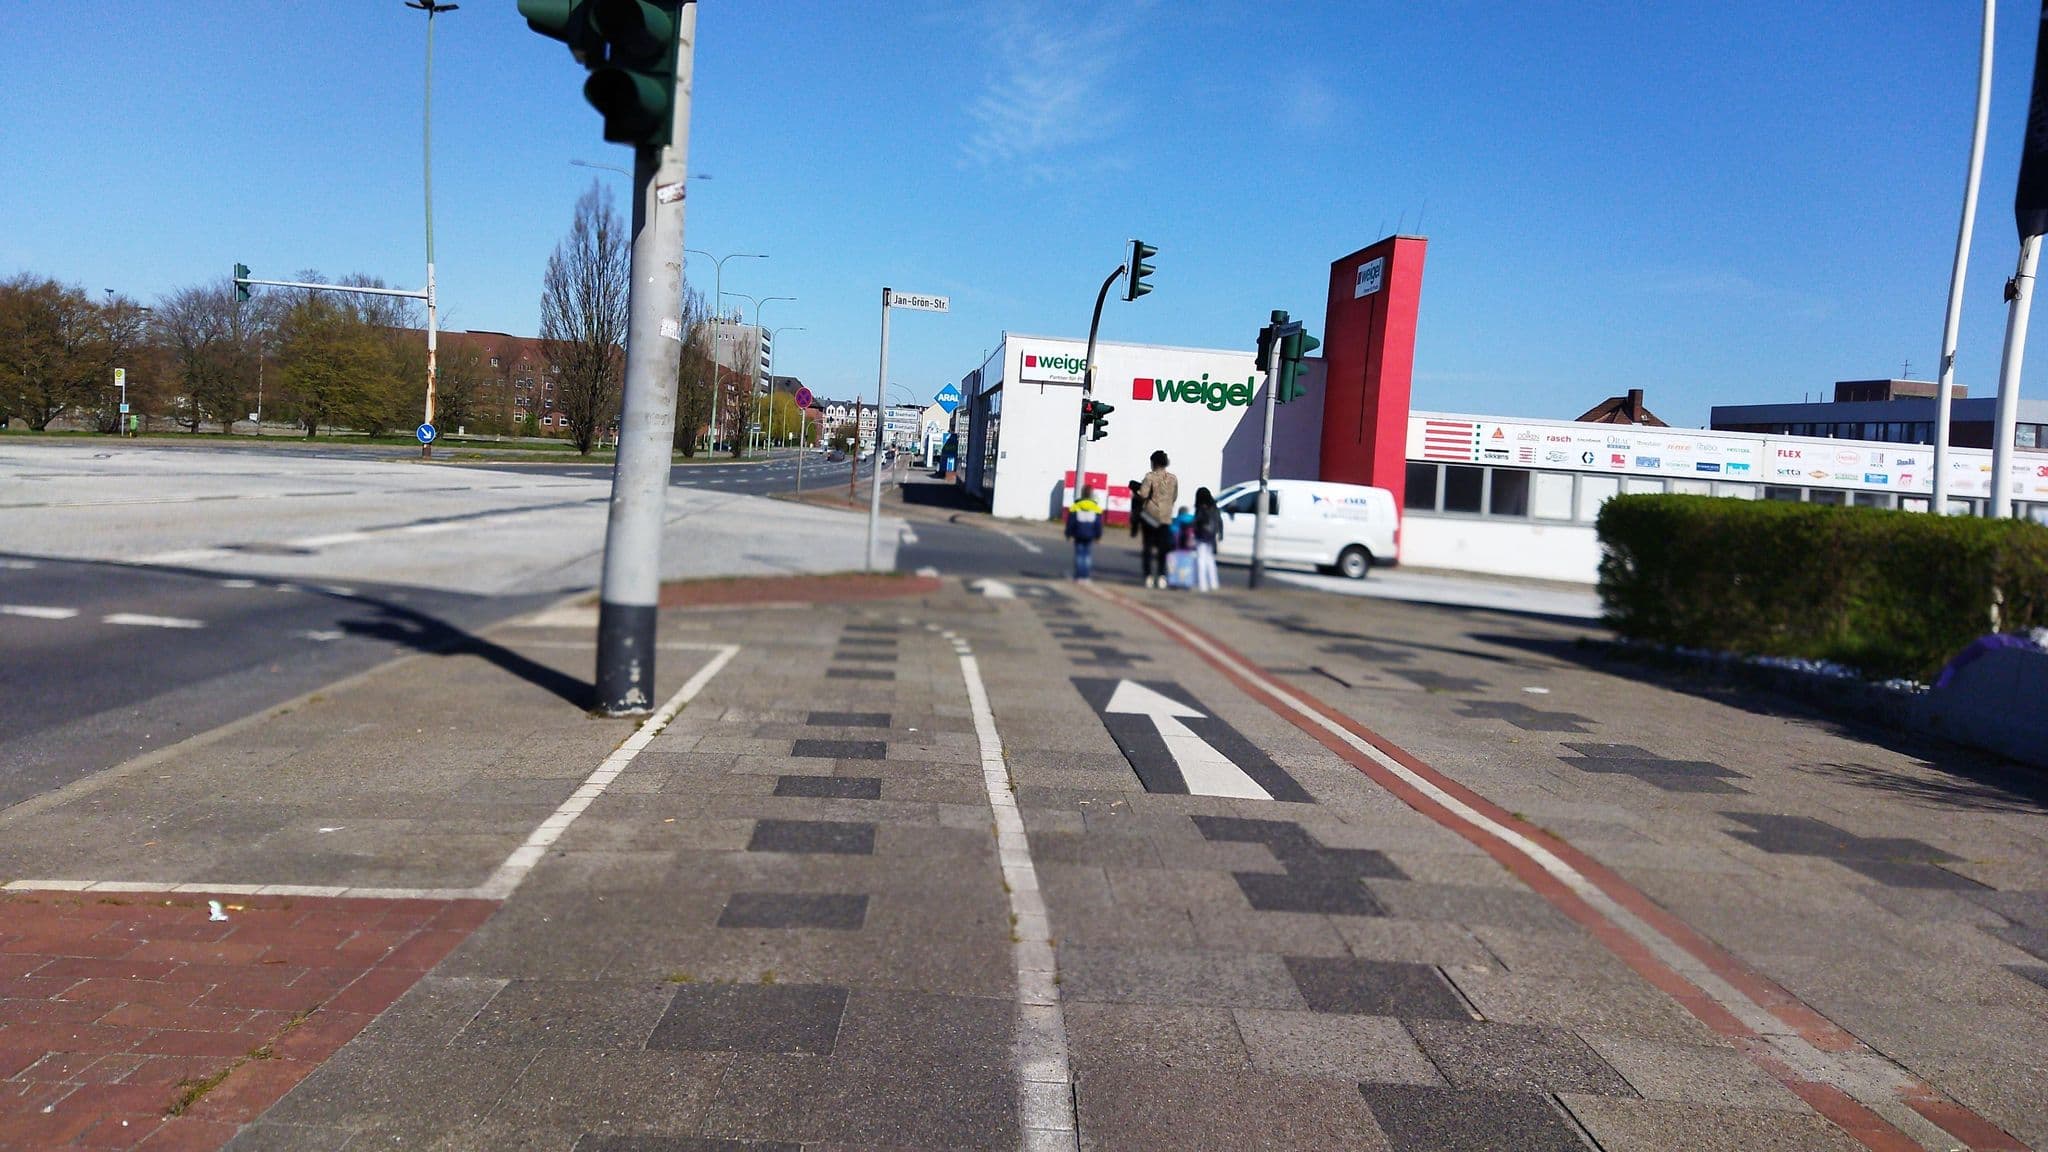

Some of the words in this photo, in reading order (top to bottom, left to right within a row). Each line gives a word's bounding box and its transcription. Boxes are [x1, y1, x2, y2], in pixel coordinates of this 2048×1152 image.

[893, 294, 947, 310] Jan-Grön-Str.
[1038, 353, 1087, 375] weige
[938, 393, 958, 402] ARAL
[1155, 373, 1255, 412] weigel
[1546, 435, 1572, 443] rasch
[1777, 449, 1802, 458] FLEX
